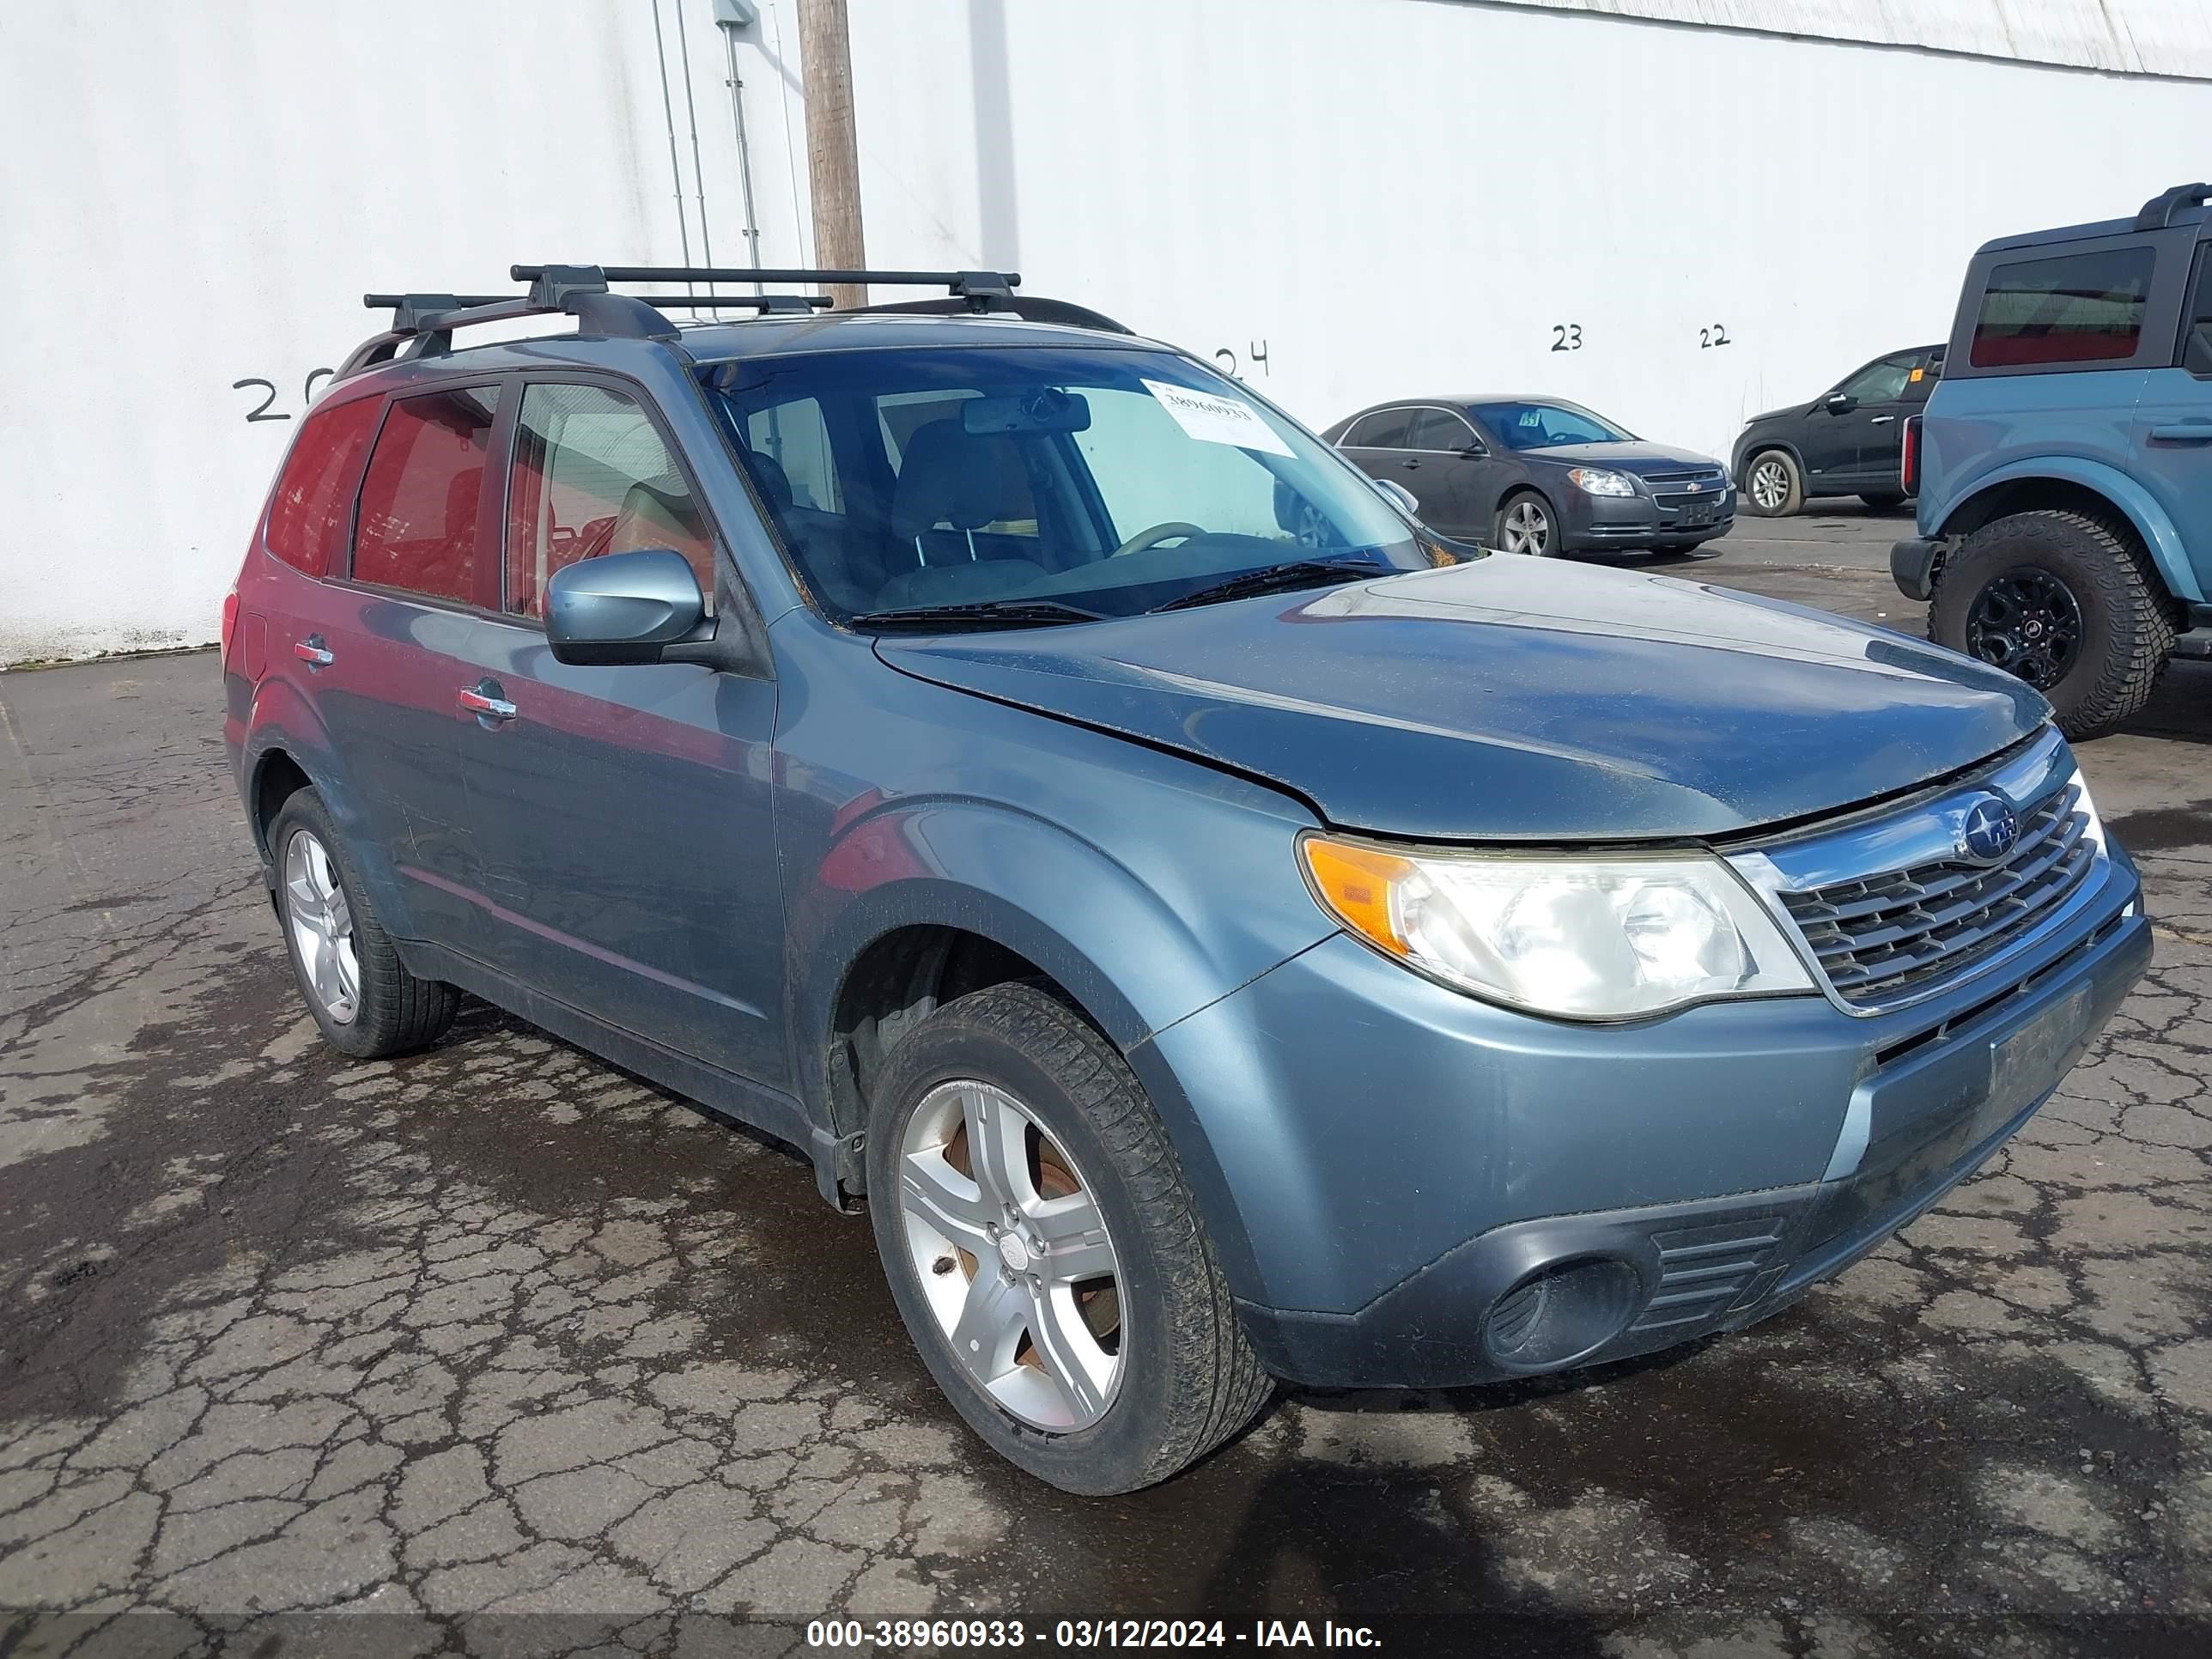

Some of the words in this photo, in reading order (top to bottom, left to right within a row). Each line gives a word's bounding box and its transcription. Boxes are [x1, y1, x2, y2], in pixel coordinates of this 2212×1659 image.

[1552, 324, 1583, 352] 23
[1700, 324, 1731, 349] 22
[1215, 339, 1268, 380] 24
[1165, 393, 1252, 422] 38960933
